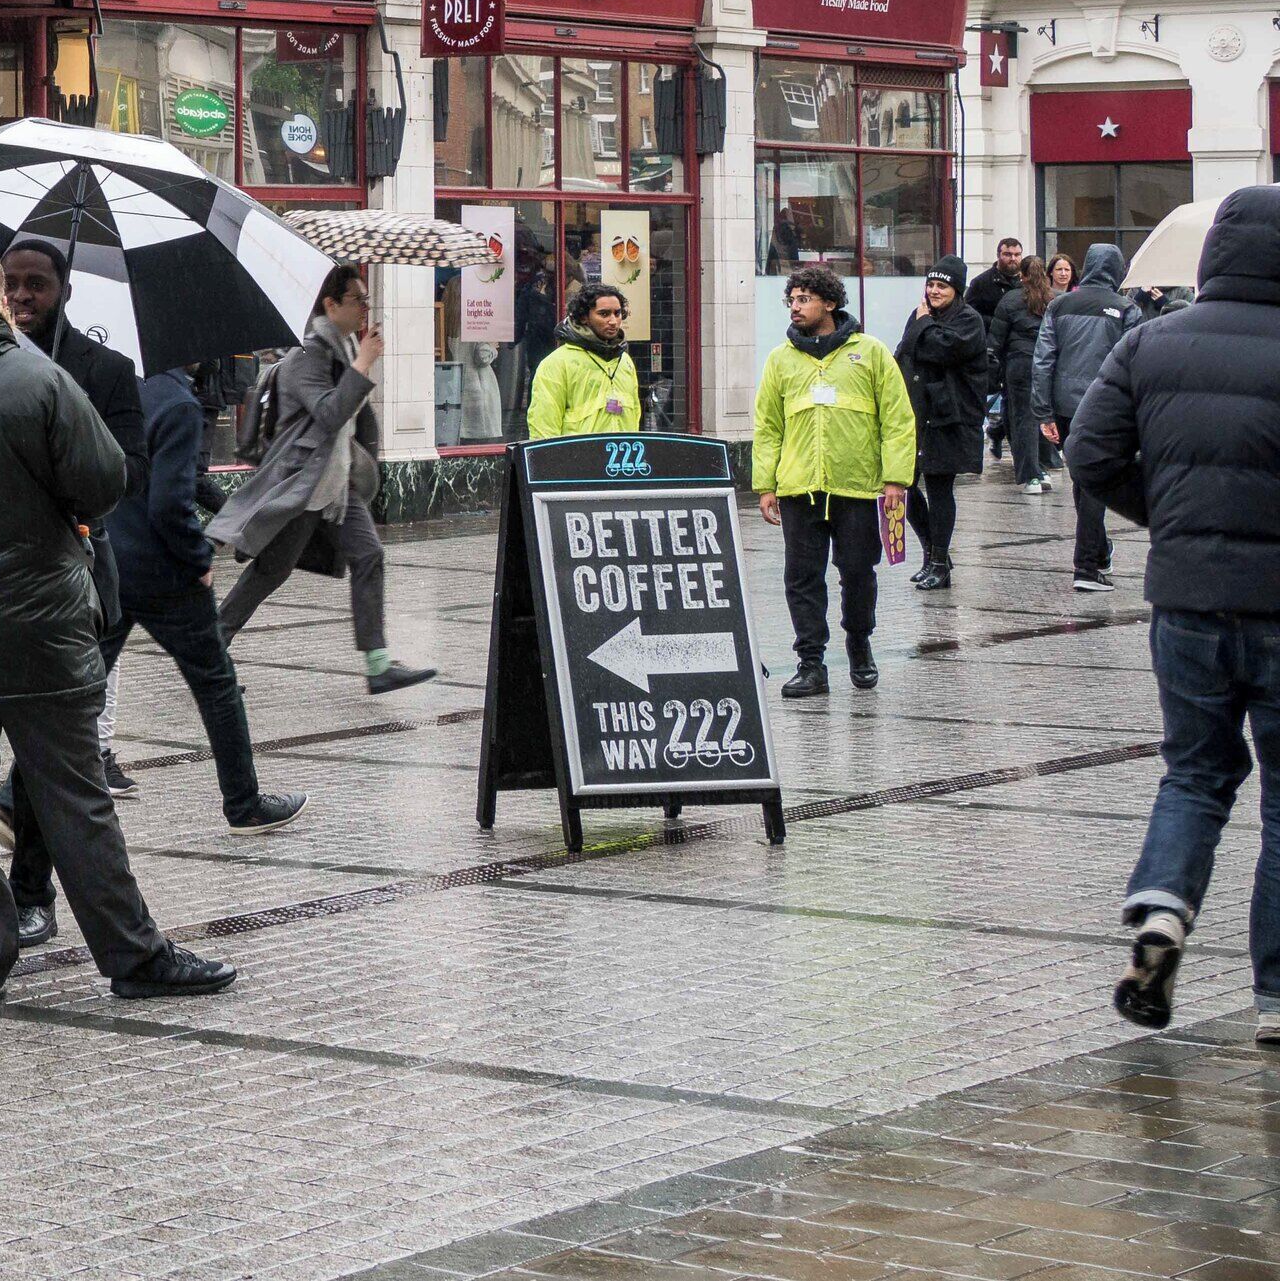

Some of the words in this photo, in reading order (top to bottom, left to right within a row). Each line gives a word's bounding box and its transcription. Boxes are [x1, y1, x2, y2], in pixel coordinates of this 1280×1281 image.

[430, 17, 456, 46] FRESHLY
[458, 35, 480, 48] MADE
[480, 15, 494, 38] FOOD
[928, 271, 951, 281] CELINE
[467, 299, 475, 307] Eat
[483, 299, 491, 307] the
[467, 308, 482, 317] bright
[483, 308, 493, 317] side
[606, 442, 646, 470] 222
[565, 509, 721, 558] BETTER
[573, 562, 730, 613] COFFEE
[593, 701, 655, 733] THIS
[663, 698, 747, 753] 222
[601, 738, 657, 770] WAY
